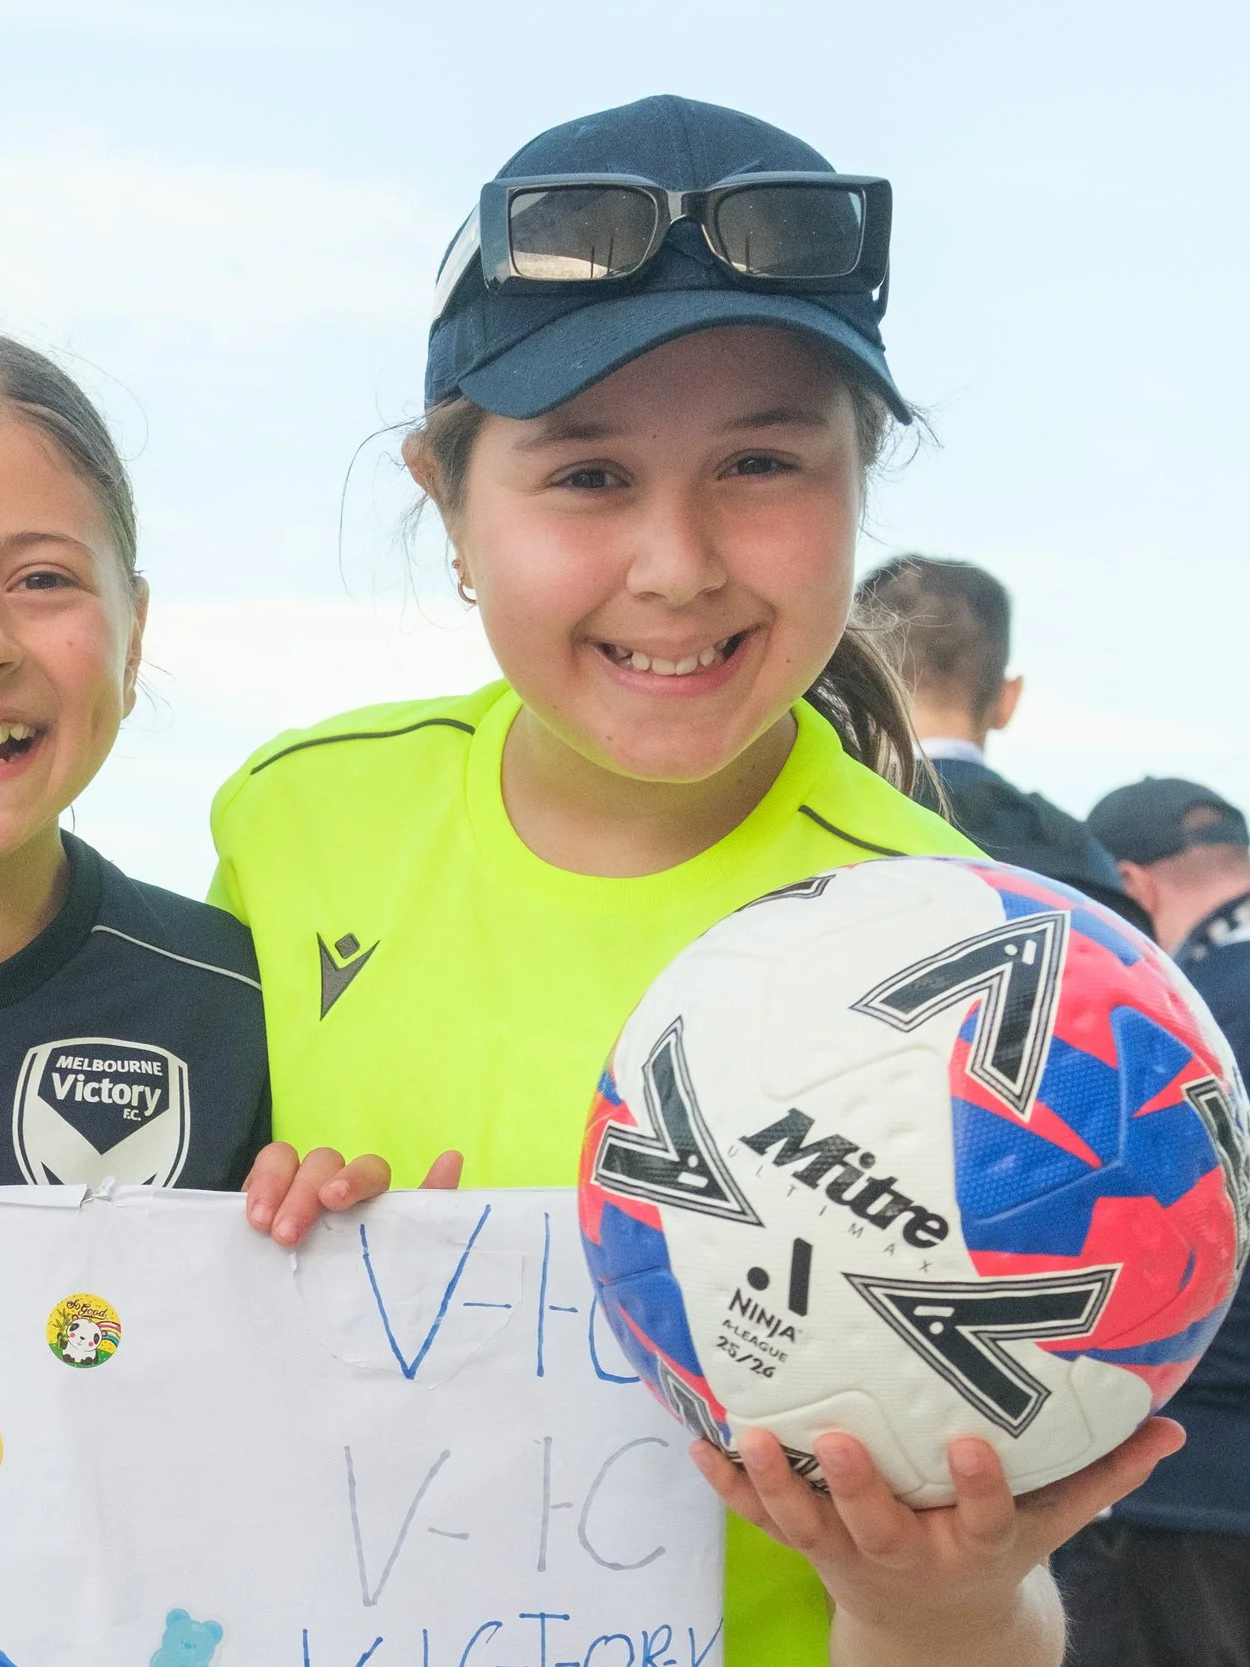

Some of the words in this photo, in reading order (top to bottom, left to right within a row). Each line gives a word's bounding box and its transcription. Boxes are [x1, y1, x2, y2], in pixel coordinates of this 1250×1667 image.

[56, 1055, 163, 1076] MELBOURNE
[52, 1072, 162, 1116] Victory
[123, 1108, 142, 1121] F.C.
[738, 1107, 950, 1249] Mitre
[78, 1303, 109, 1319] Good
[728, 1287, 796, 1344] NINJA
[716, 1335, 777, 1378] 25/26
[721, 1318, 788, 1363] A-LEAGUE
